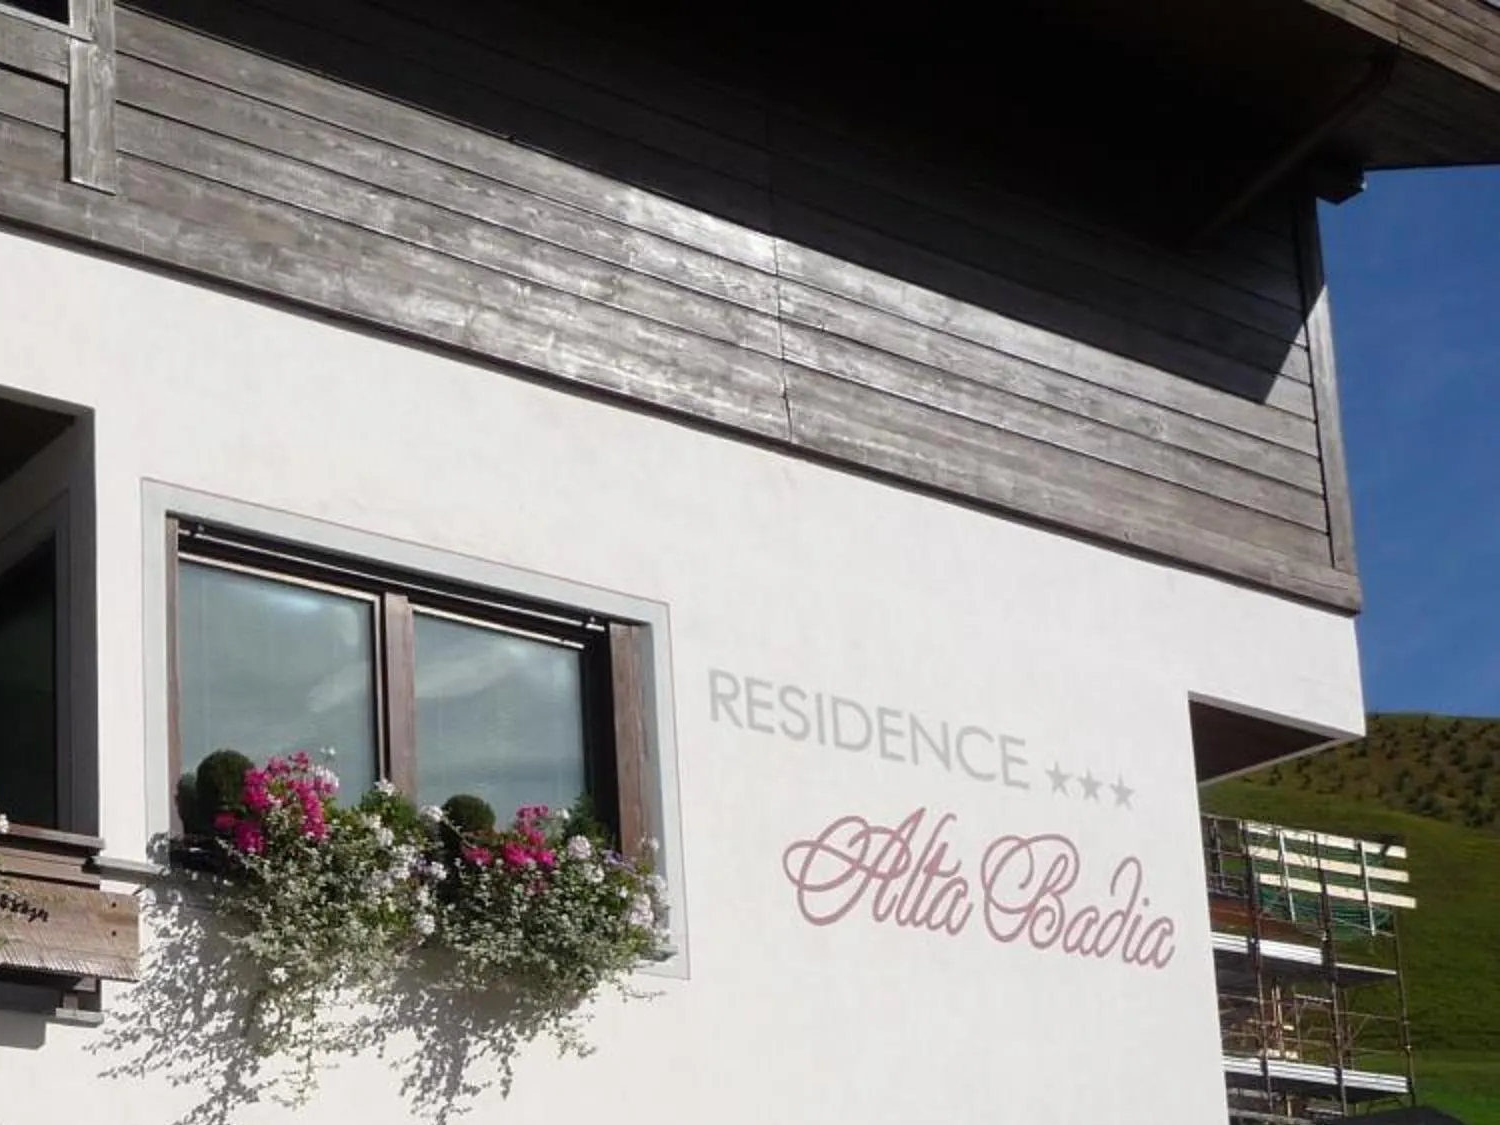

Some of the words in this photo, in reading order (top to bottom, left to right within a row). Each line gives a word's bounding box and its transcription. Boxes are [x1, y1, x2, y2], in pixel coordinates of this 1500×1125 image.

[709, 669, 1030, 789] RESIDENCE
[783, 807, 974, 935] Alta
[981, 834, 1176, 969] Badia
